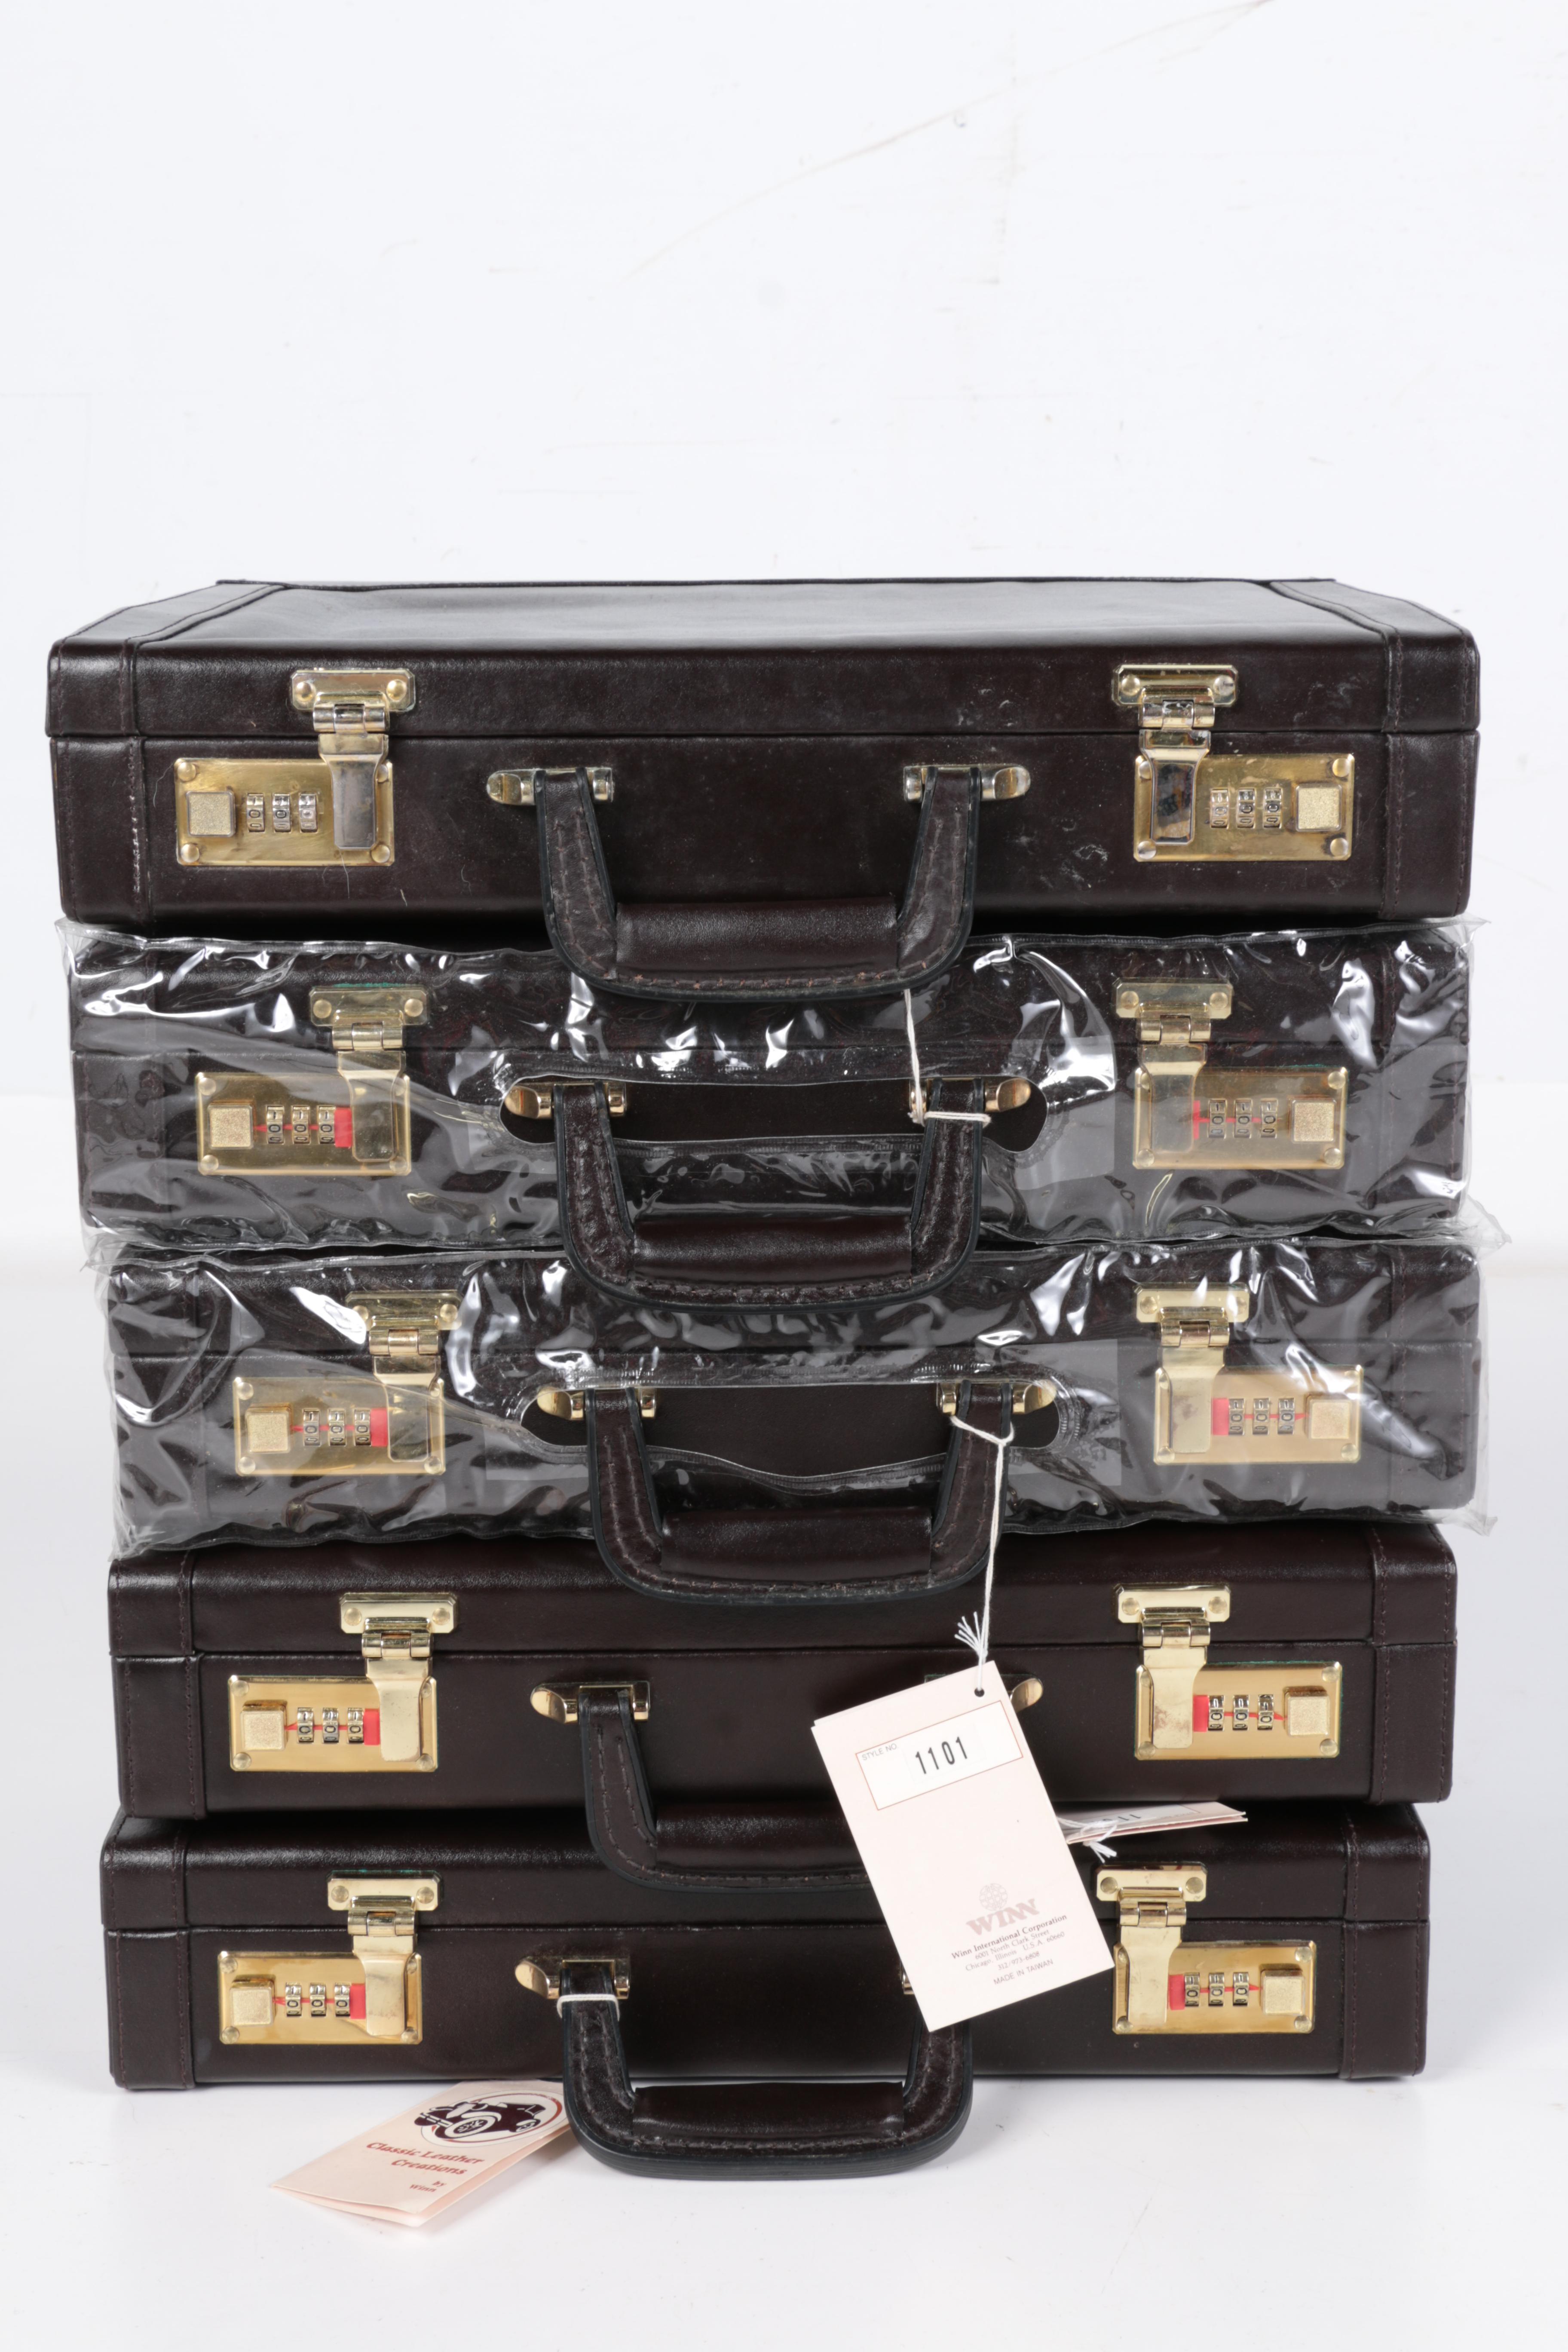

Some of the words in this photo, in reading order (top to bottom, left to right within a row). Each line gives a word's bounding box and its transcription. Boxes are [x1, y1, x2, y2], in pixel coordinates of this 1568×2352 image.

[862, 1748, 884, 1761] STYLE
[915, 1736, 967, 1774] 1101
[966, 1898, 1040, 1936] WINN
[952, 1948, 972, 1959] Winn
[974, 1930, 1020, 1952] International
[1022, 1915, 1067, 1934] Corporation
[965, 1959, 993, 1971] Chicago,
[995, 1949, 1017, 1960] Illinois
[1047, 1931, 1065, 1942] 60660
[975, 1951, 989, 1960] 6001
[990, 1944, 1010, 1954] North
[1011, 1936, 1029, 1946] Clark
[1031, 1929, 1050, 1940] Street
[994, 1972, 1015, 1984] MADE
[1027, 1959, 1053, 1972] TAIWAN
[998, 1951, 1040, 1970] 312/973-6808
[366, 2143, 420, 2156] Classic
[420, 2151, 485, 2164] Leather
[392, 2159, 467, 2174] Creations
